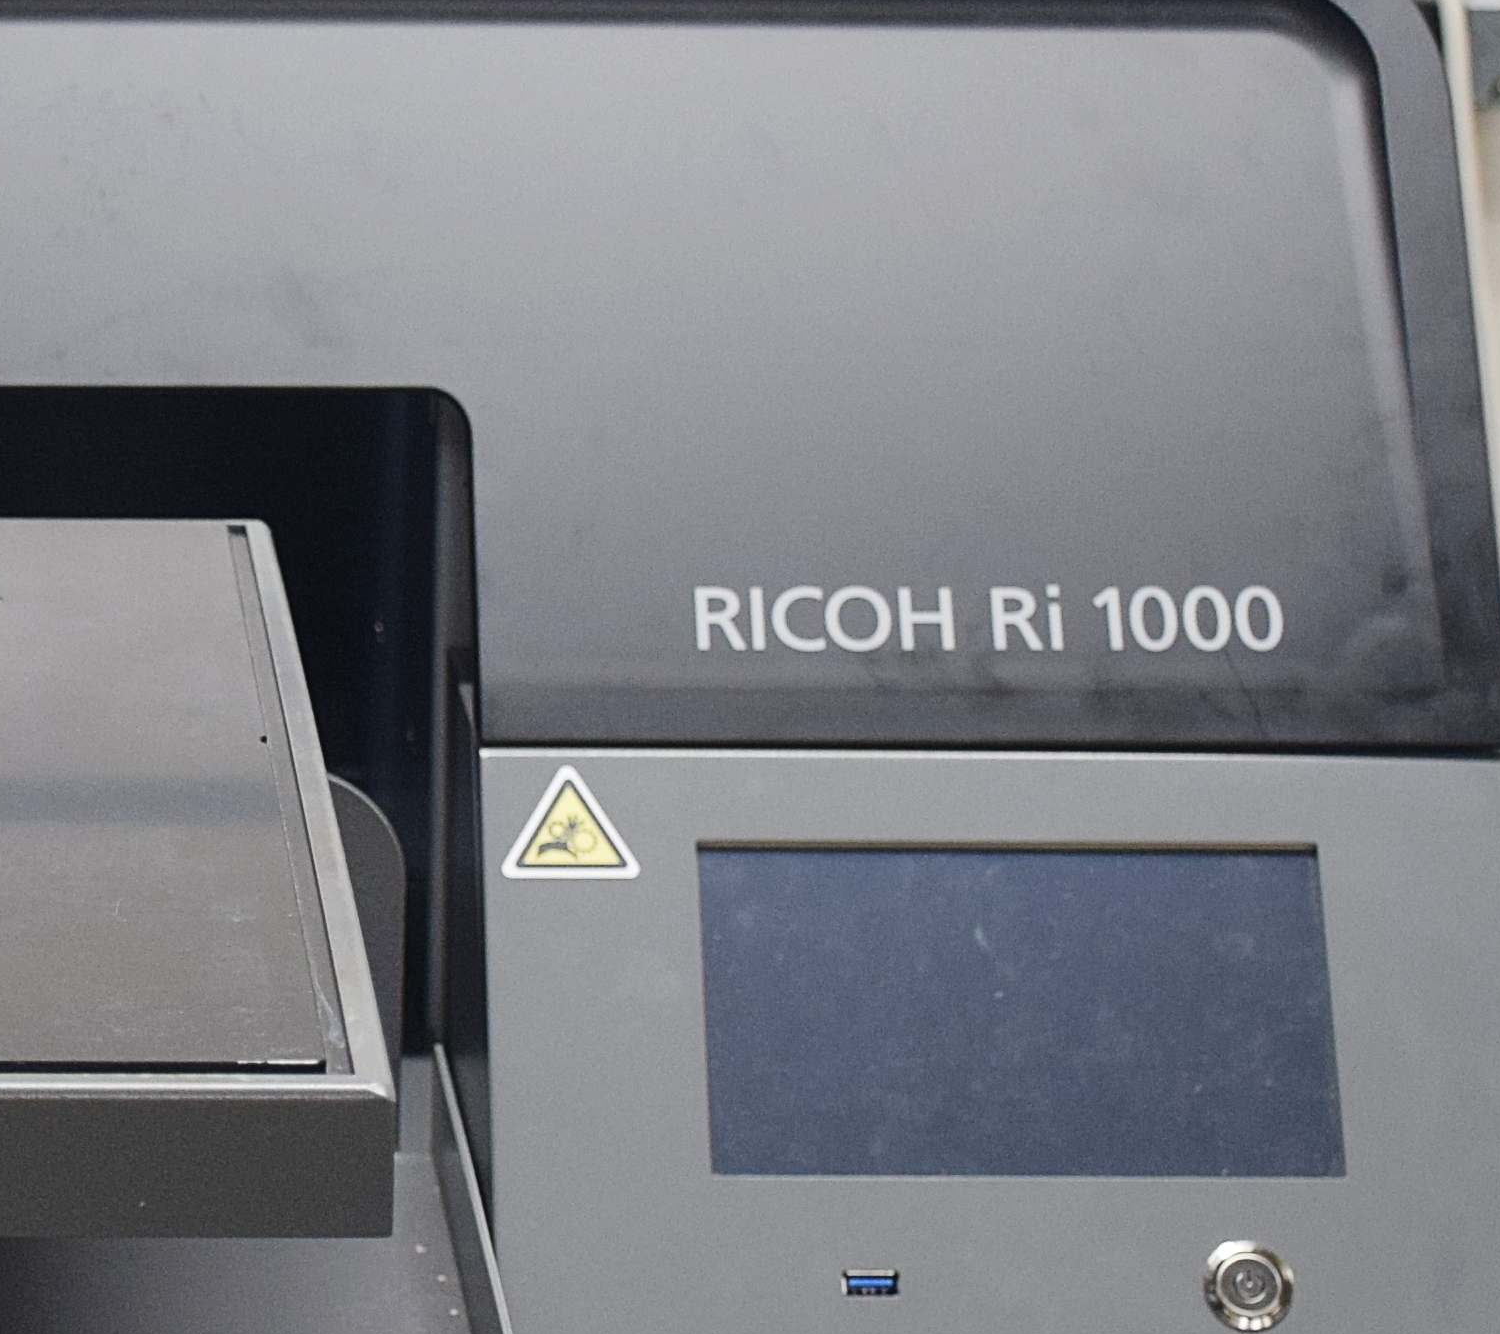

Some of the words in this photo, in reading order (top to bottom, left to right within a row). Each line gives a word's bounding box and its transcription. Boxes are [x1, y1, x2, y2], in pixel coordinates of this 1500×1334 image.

[693, 584, 955, 653] RICOH
[991, 583, 1065, 653] Ri
[1091, 584, 1285, 654] 1000
